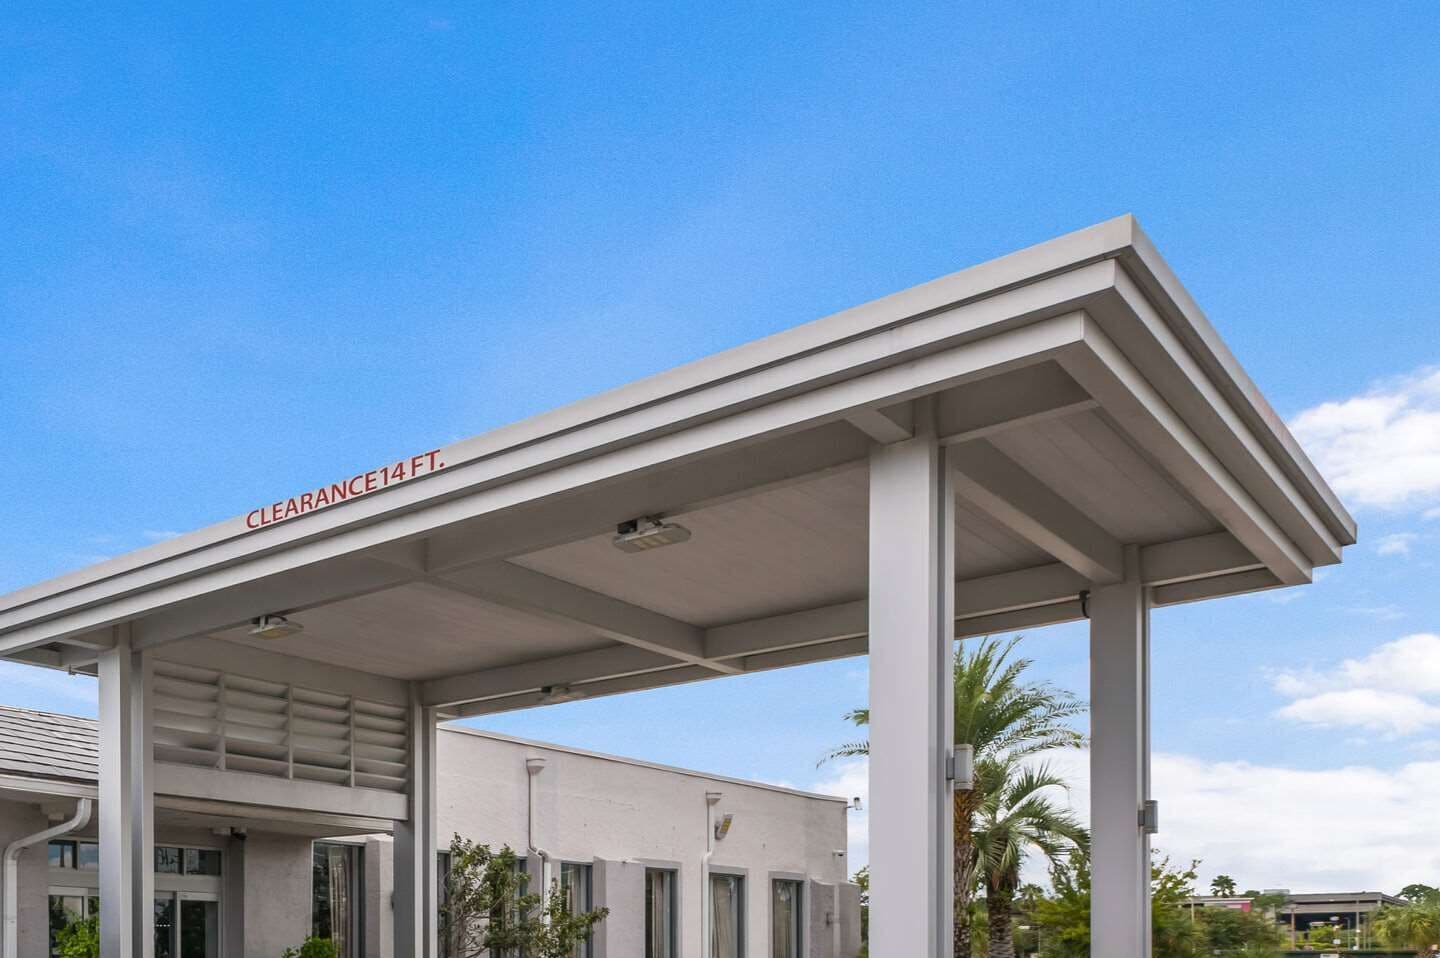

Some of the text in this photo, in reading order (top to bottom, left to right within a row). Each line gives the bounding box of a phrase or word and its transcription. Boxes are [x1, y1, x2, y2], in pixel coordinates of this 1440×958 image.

[246, 449, 445, 529] CLEARANCE 14 FT.
